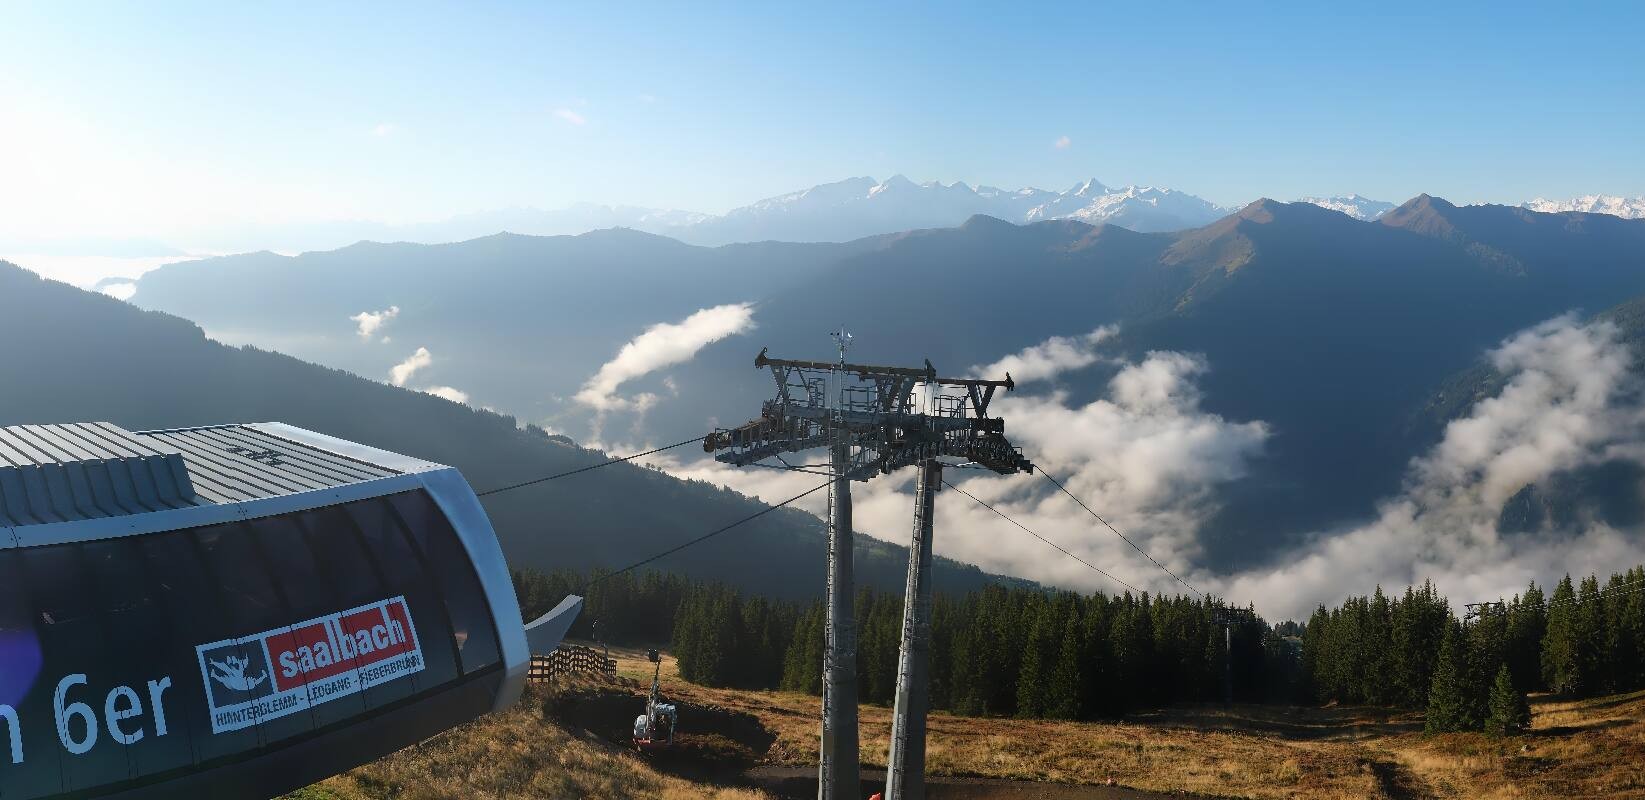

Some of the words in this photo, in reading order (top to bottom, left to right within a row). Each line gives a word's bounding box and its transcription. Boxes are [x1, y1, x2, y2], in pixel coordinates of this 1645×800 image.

[279, 605, 406, 678] saalbach
[54, 673, 172, 755] 6er
[307, 676, 352, 701] LEOGANG
